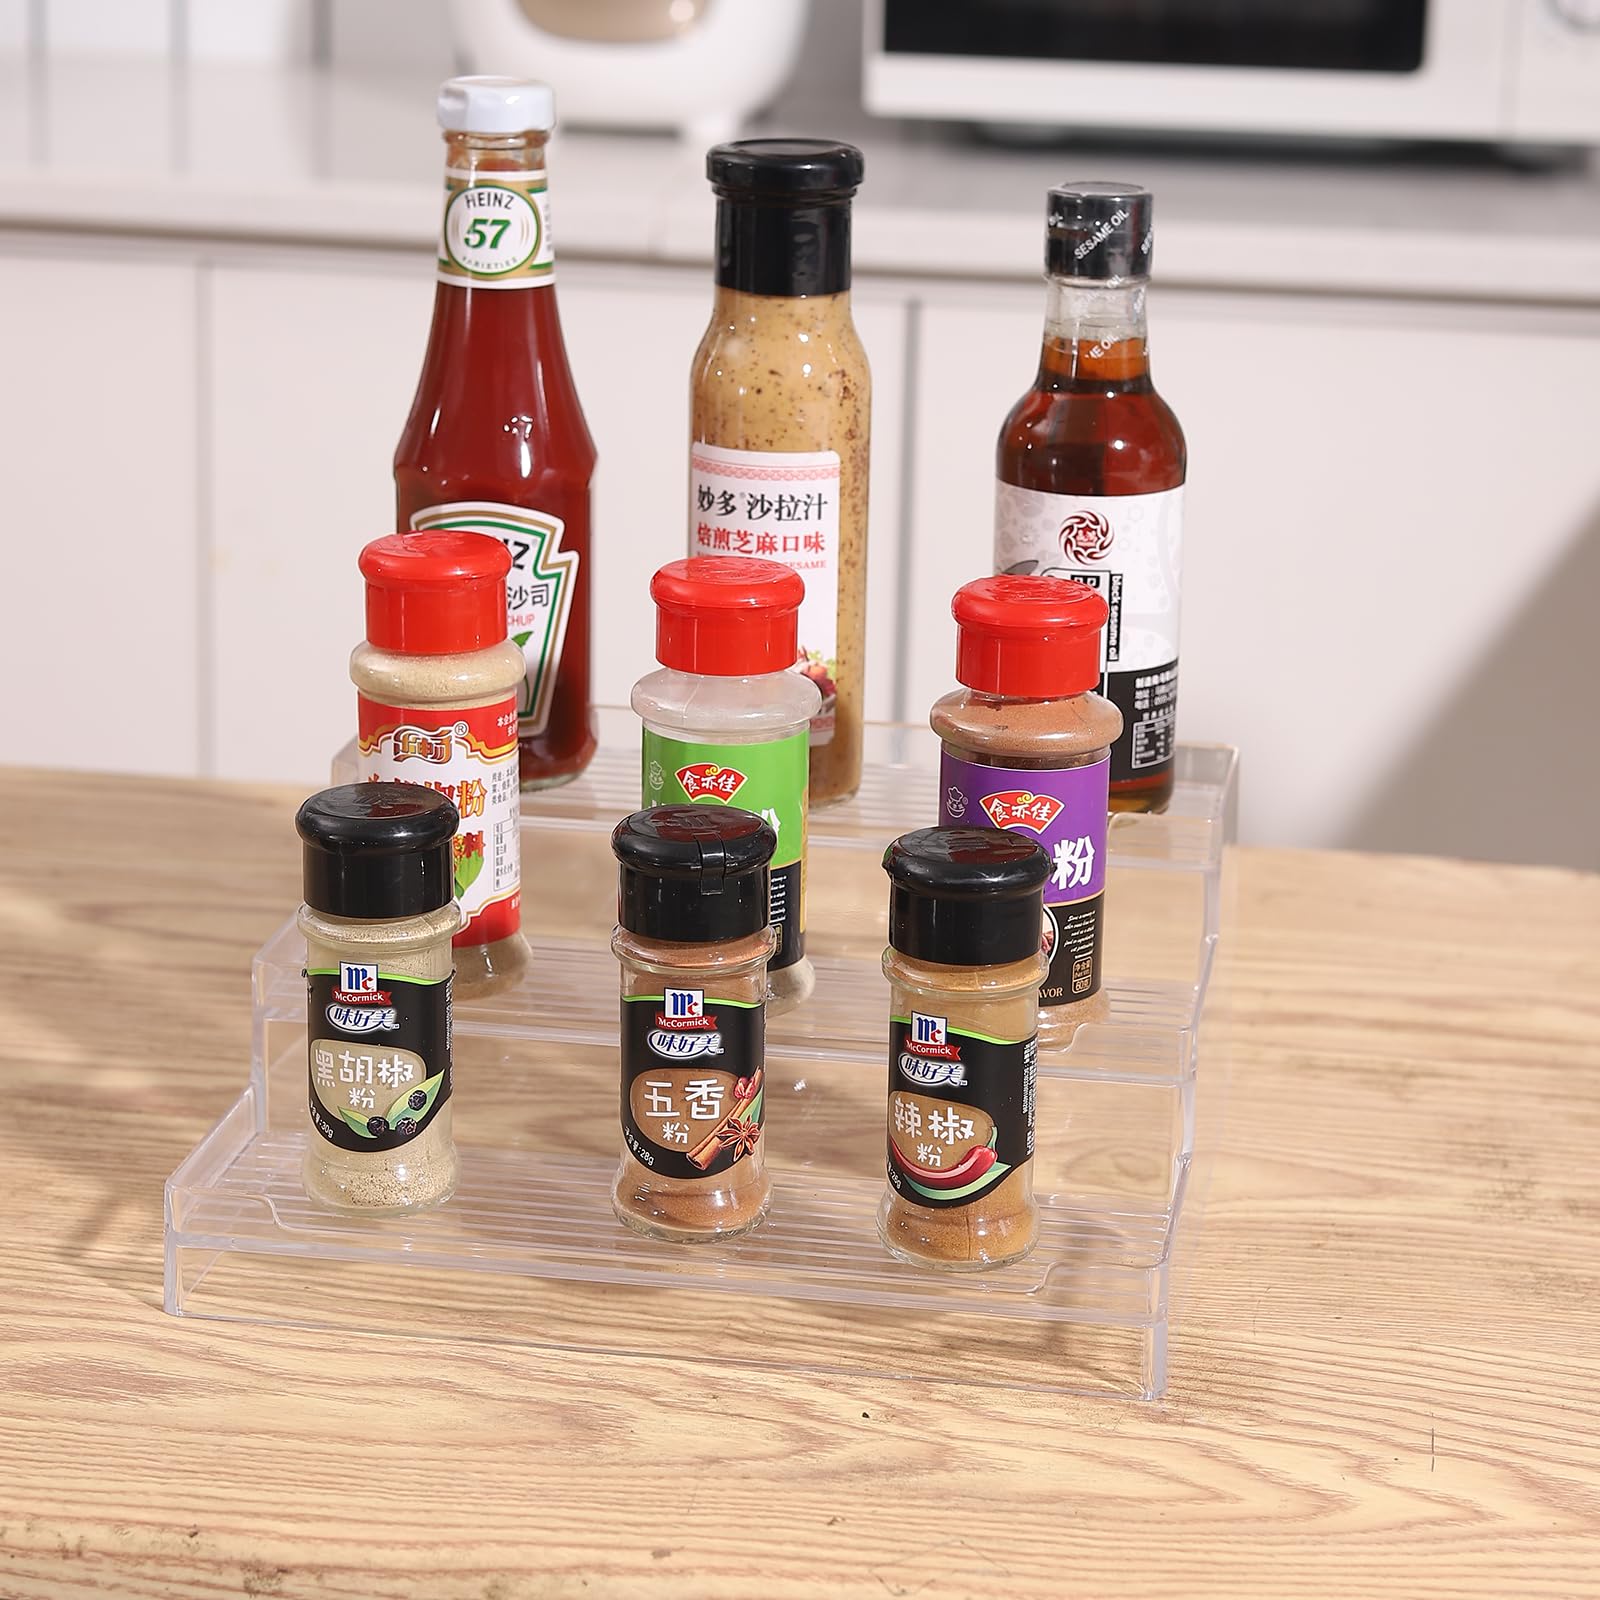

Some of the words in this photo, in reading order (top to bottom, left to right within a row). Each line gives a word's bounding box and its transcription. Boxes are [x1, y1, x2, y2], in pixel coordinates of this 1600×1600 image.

[464, 191, 514, 210] HEINZ
[464, 218, 511, 249] 57
[1074, 222, 1114, 260] SESAME
[1110, 209, 1130, 226] OIL
[697, 484, 737, 517] 妙多
[746, 492, 828, 521] 沙拉汁
[696, 522, 826, 555] 焙煎芝麻口味
[682, 769, 737, 793] 食亦佳
[989, 798, 1052, 822] 食亦佳
[1051, 836, 1095, 890] 粉
[335, 991, 384, 1003] McCormick
[333, 1006, 395, 1029] 味好美
[658, 1017, 710, 1028] McCormick
[656, 1033, 720, 1054] 味好美
[906, 1040, 952, 1056] McCormick
[315, 1049, 414, 1088] 黑胡椒
[904, 1057, 964, 1085] 味好美
[349, 1087, 376, 1109] 粉
[644, 1078, 725, 1120] 五香
[662, 1121, 690, 1144] 粉
[894, 1098, 975, 1145] 辣椒
[916, 1142, 943, 1167] 粉
